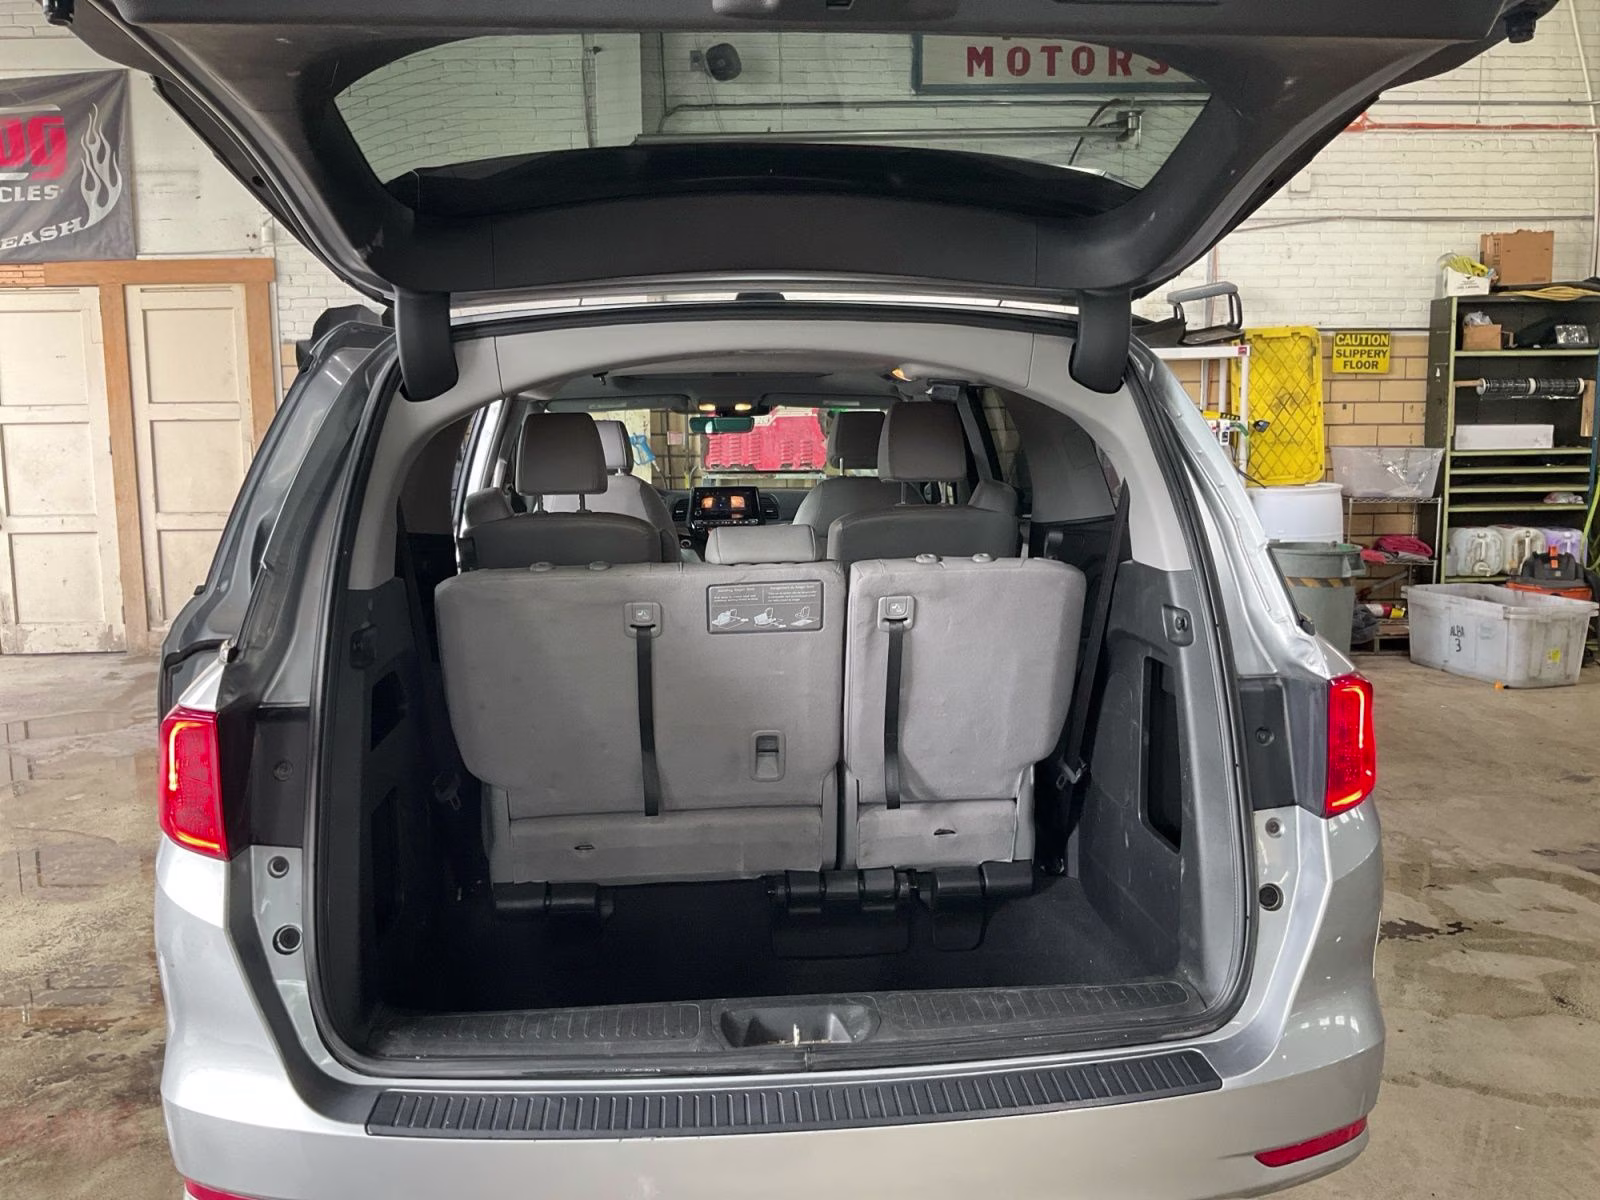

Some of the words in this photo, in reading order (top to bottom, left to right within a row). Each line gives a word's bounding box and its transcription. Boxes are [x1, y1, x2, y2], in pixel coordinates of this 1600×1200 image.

[0, 216, 85, 250] EASH
[1335, 334, 1389, 346] CAUTION
[1335, 348, 1388, 359] SLIPPERY
[1343, 360, 1379, 370] FLOOR
[1454, 638, 1462, 652] 3
